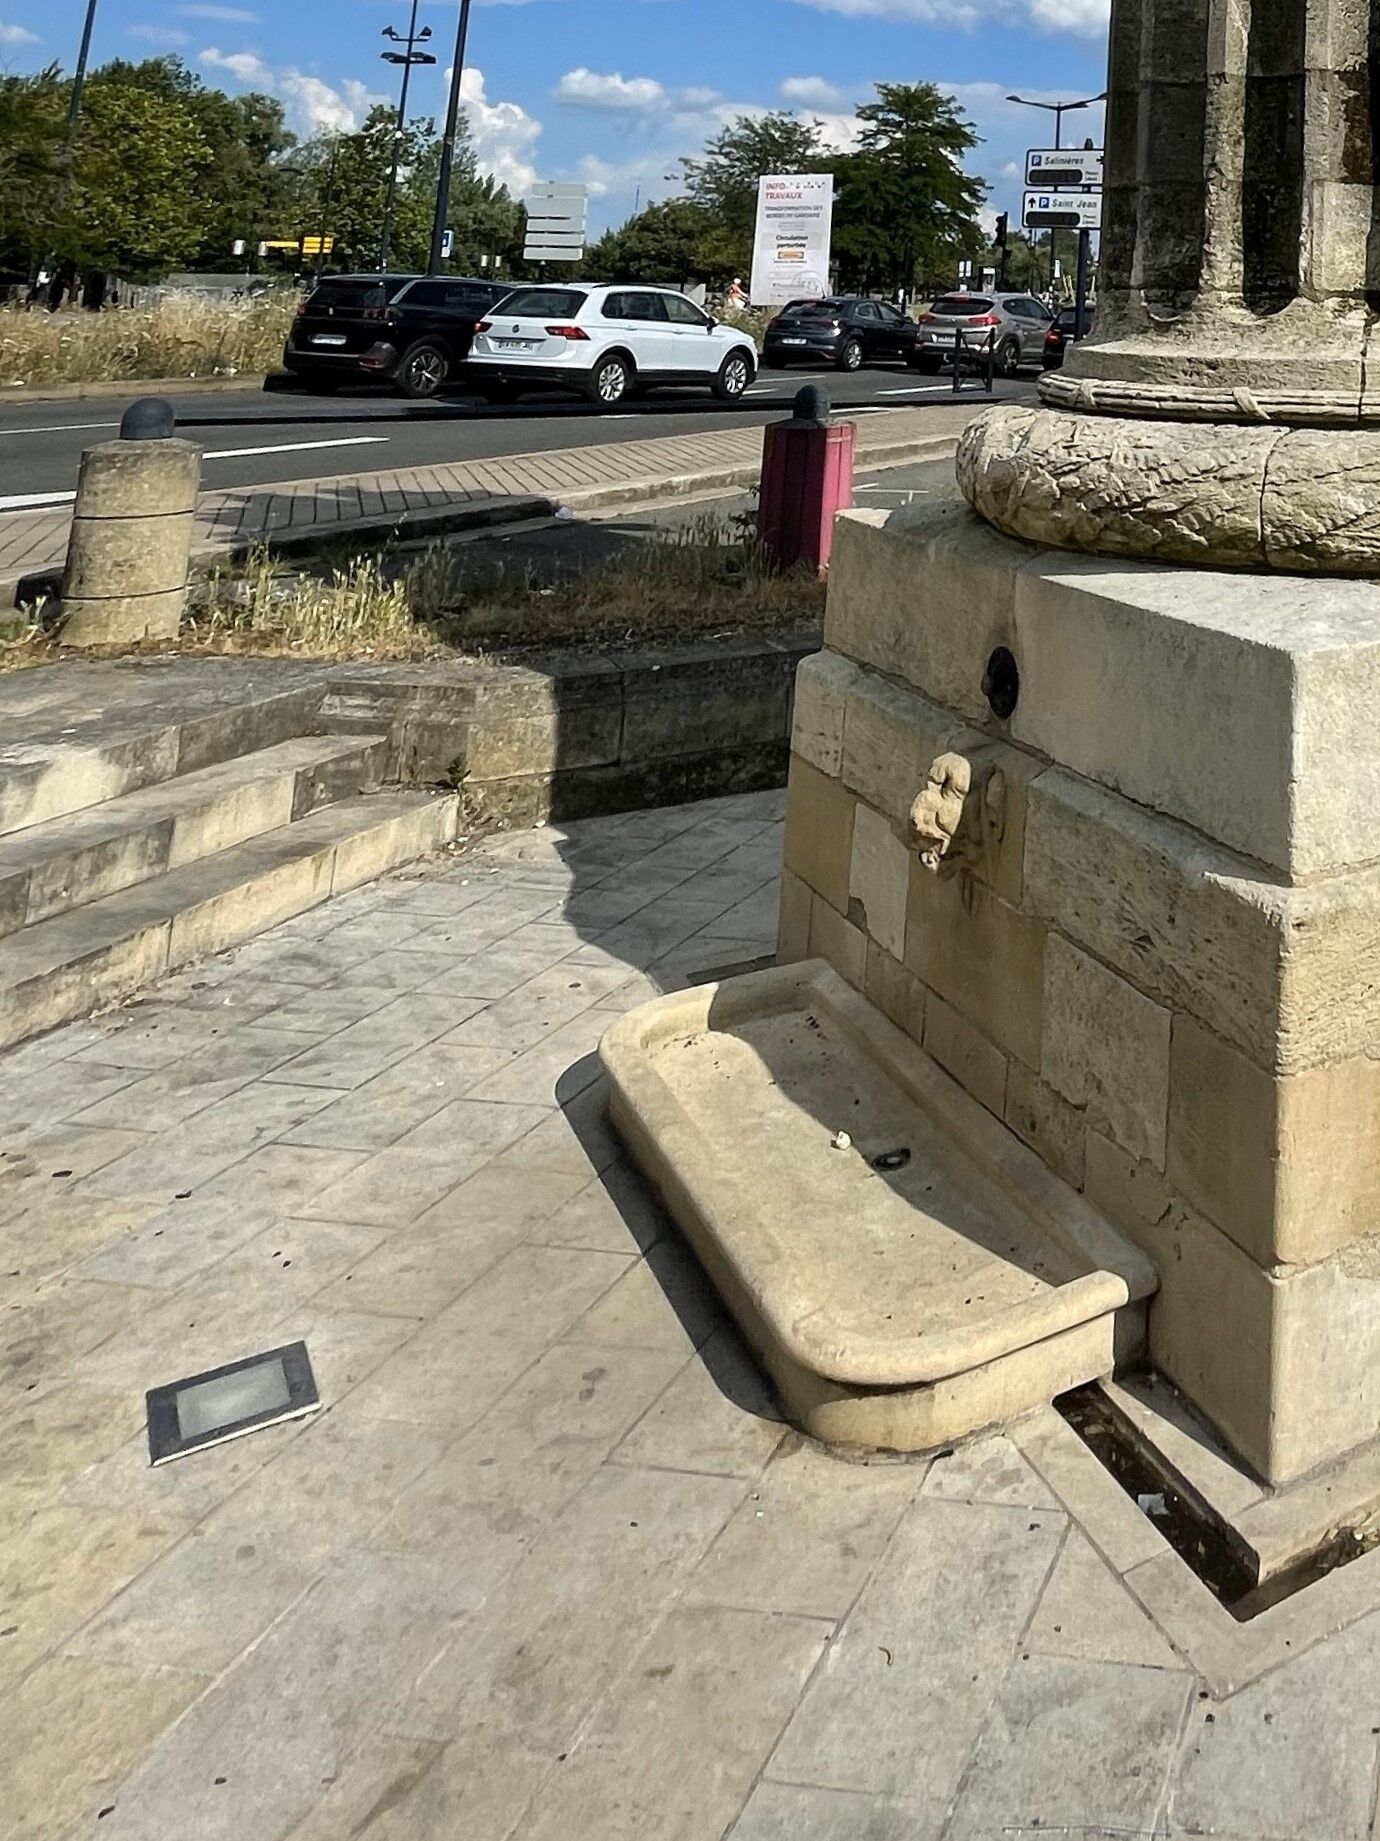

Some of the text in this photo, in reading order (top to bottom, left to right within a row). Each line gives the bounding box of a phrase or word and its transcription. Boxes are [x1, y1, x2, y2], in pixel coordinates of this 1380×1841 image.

[765, 182, 786, 190] INFO
[1052, 198, 1074, 208] Saint
[1076, 199, 1097, 208] Jean
